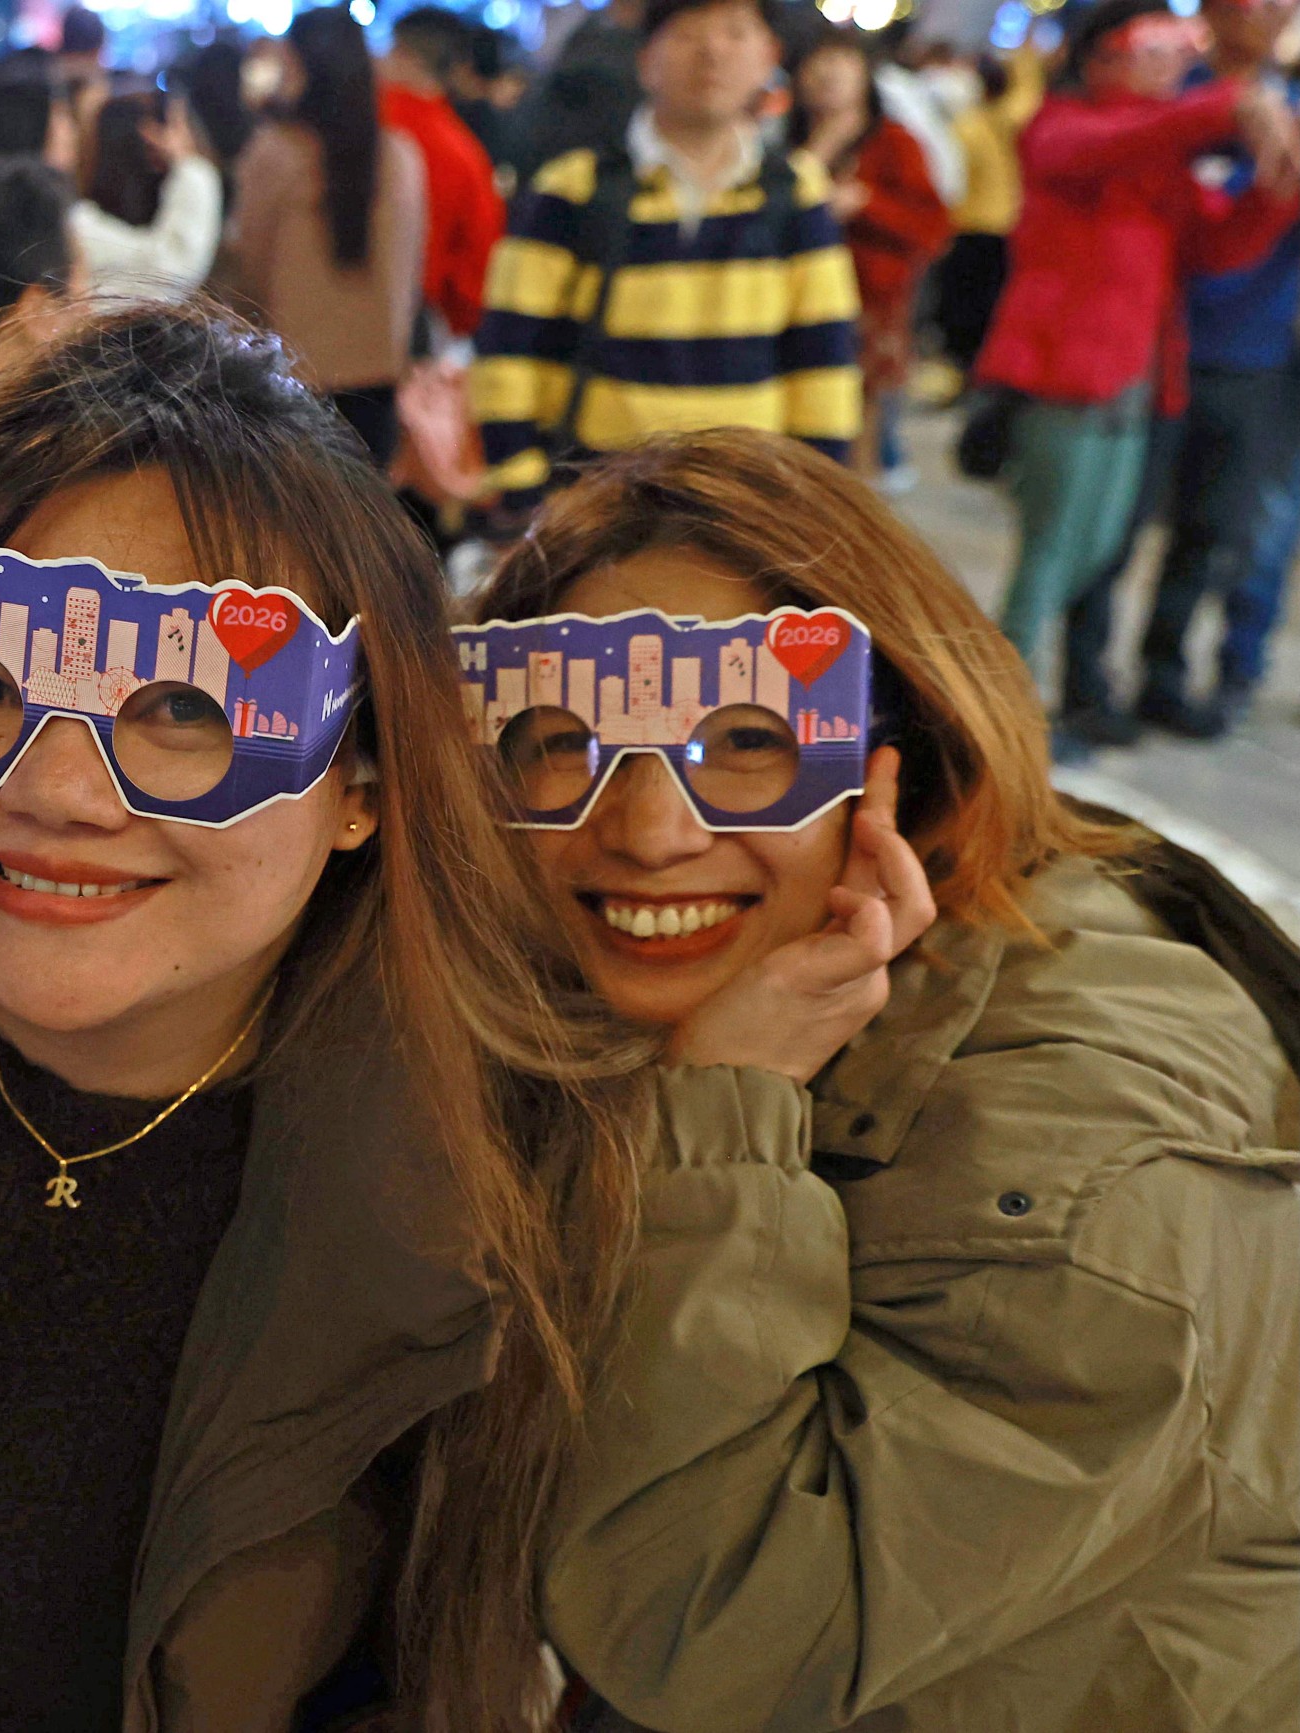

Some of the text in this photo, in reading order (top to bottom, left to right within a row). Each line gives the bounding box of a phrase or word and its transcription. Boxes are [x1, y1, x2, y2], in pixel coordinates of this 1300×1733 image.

[223, 605, 288, 632] 2026
[779, 626, 840, 648] 2026
[45, 1176, 81, 1208] R
